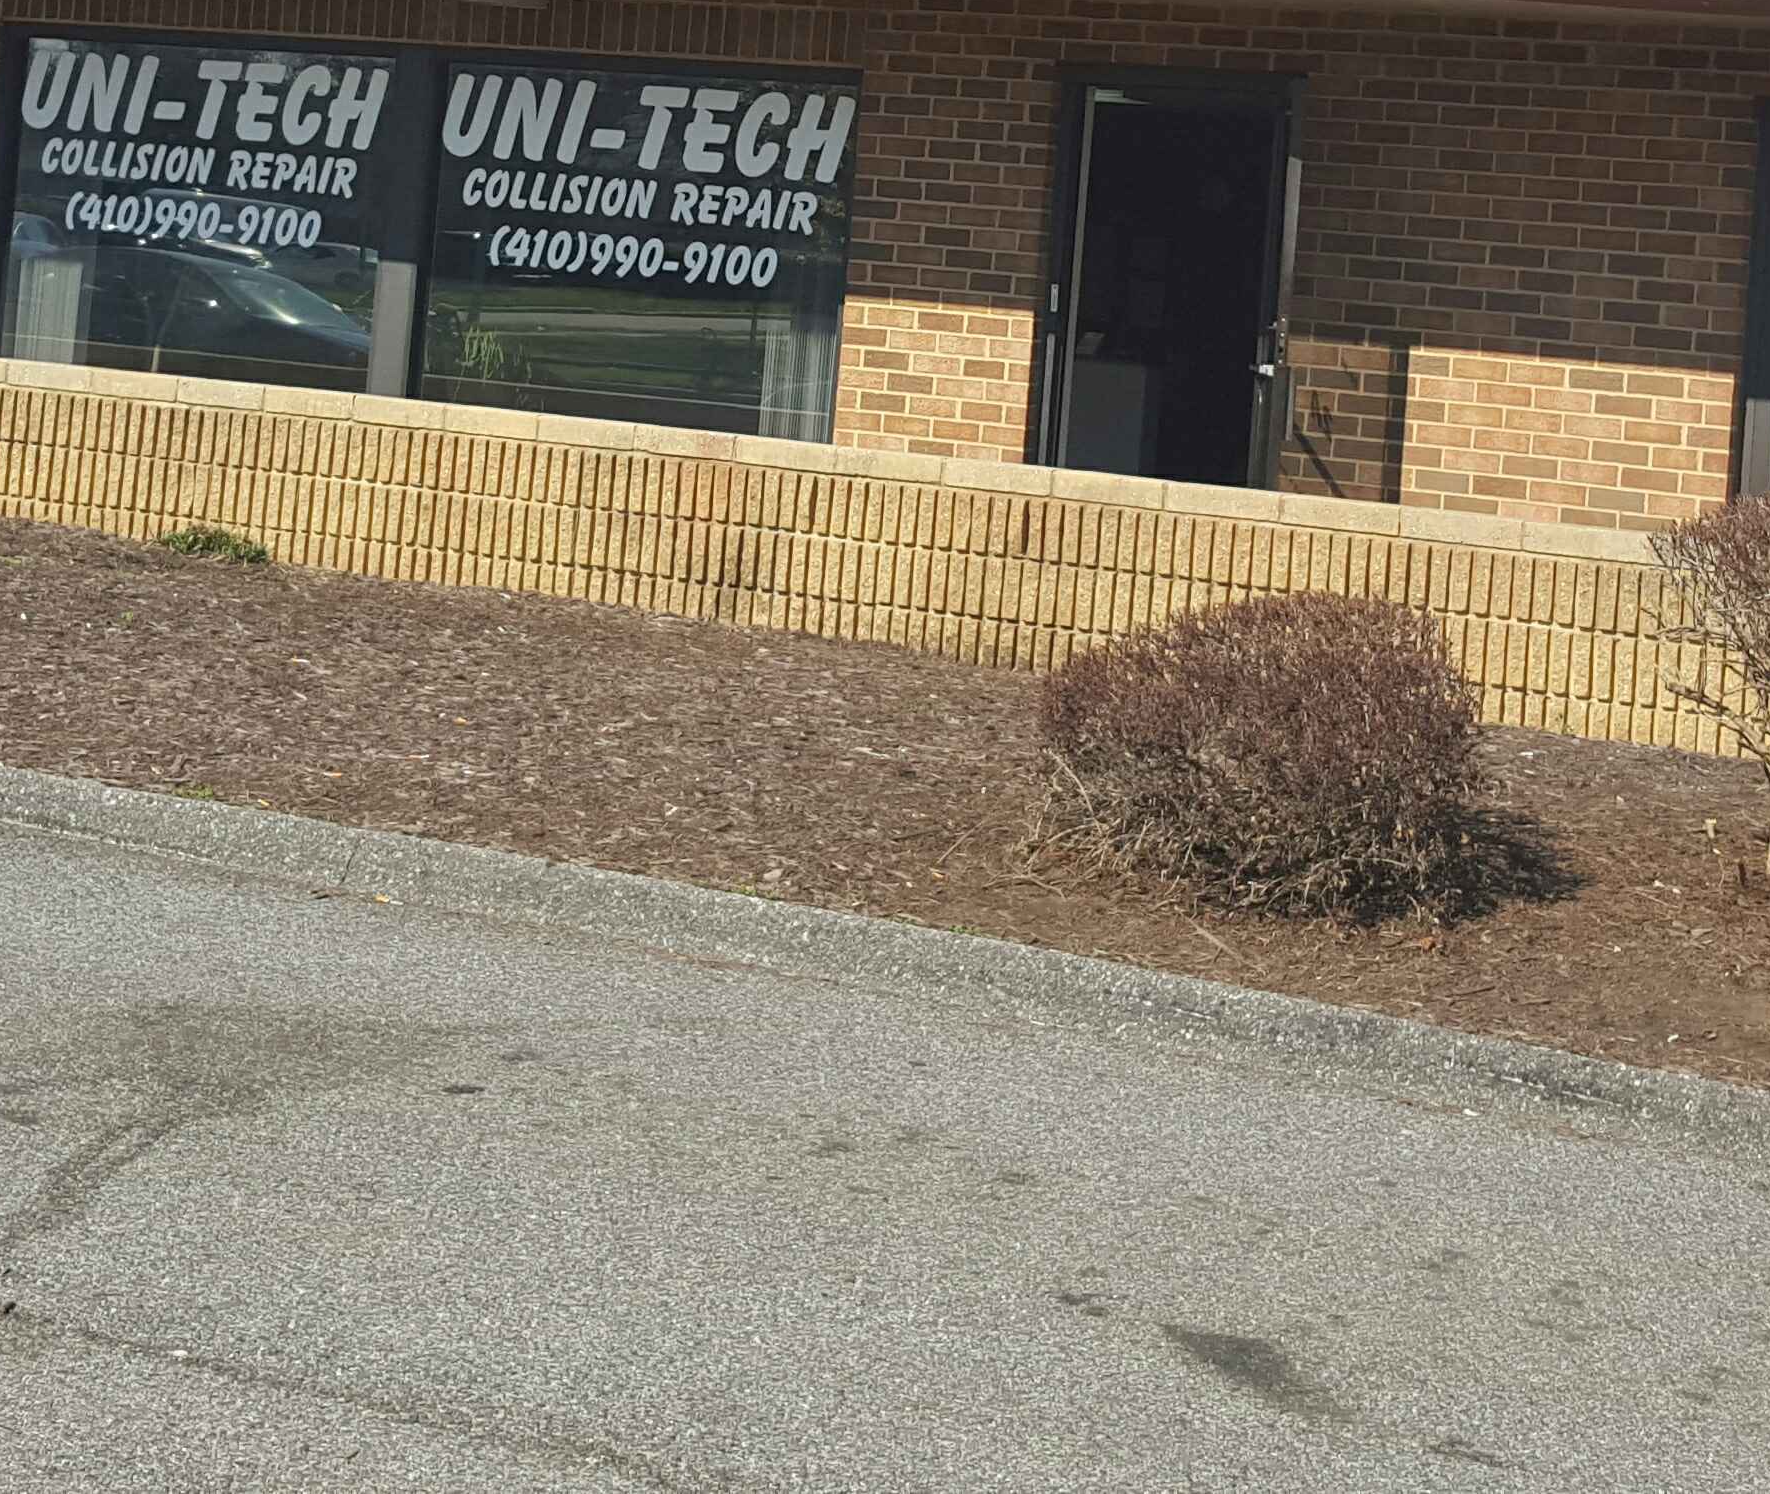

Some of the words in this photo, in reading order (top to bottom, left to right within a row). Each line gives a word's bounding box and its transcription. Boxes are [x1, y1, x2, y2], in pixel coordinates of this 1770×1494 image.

[21, 49, 390, 151] UNI-TECH
[442, 73, 856, 183] UNI-TECH
[41, 137, 216, 184] COLLISION
[226, 150, 358, 199] REPAIR
[65, 191, 322, 248] (410)990-9100
[462, 168, 658, 219] COLLISION
[670, 183, 818, 235] REPAIR
[488, 225, 778, 287] (410)990-9100
